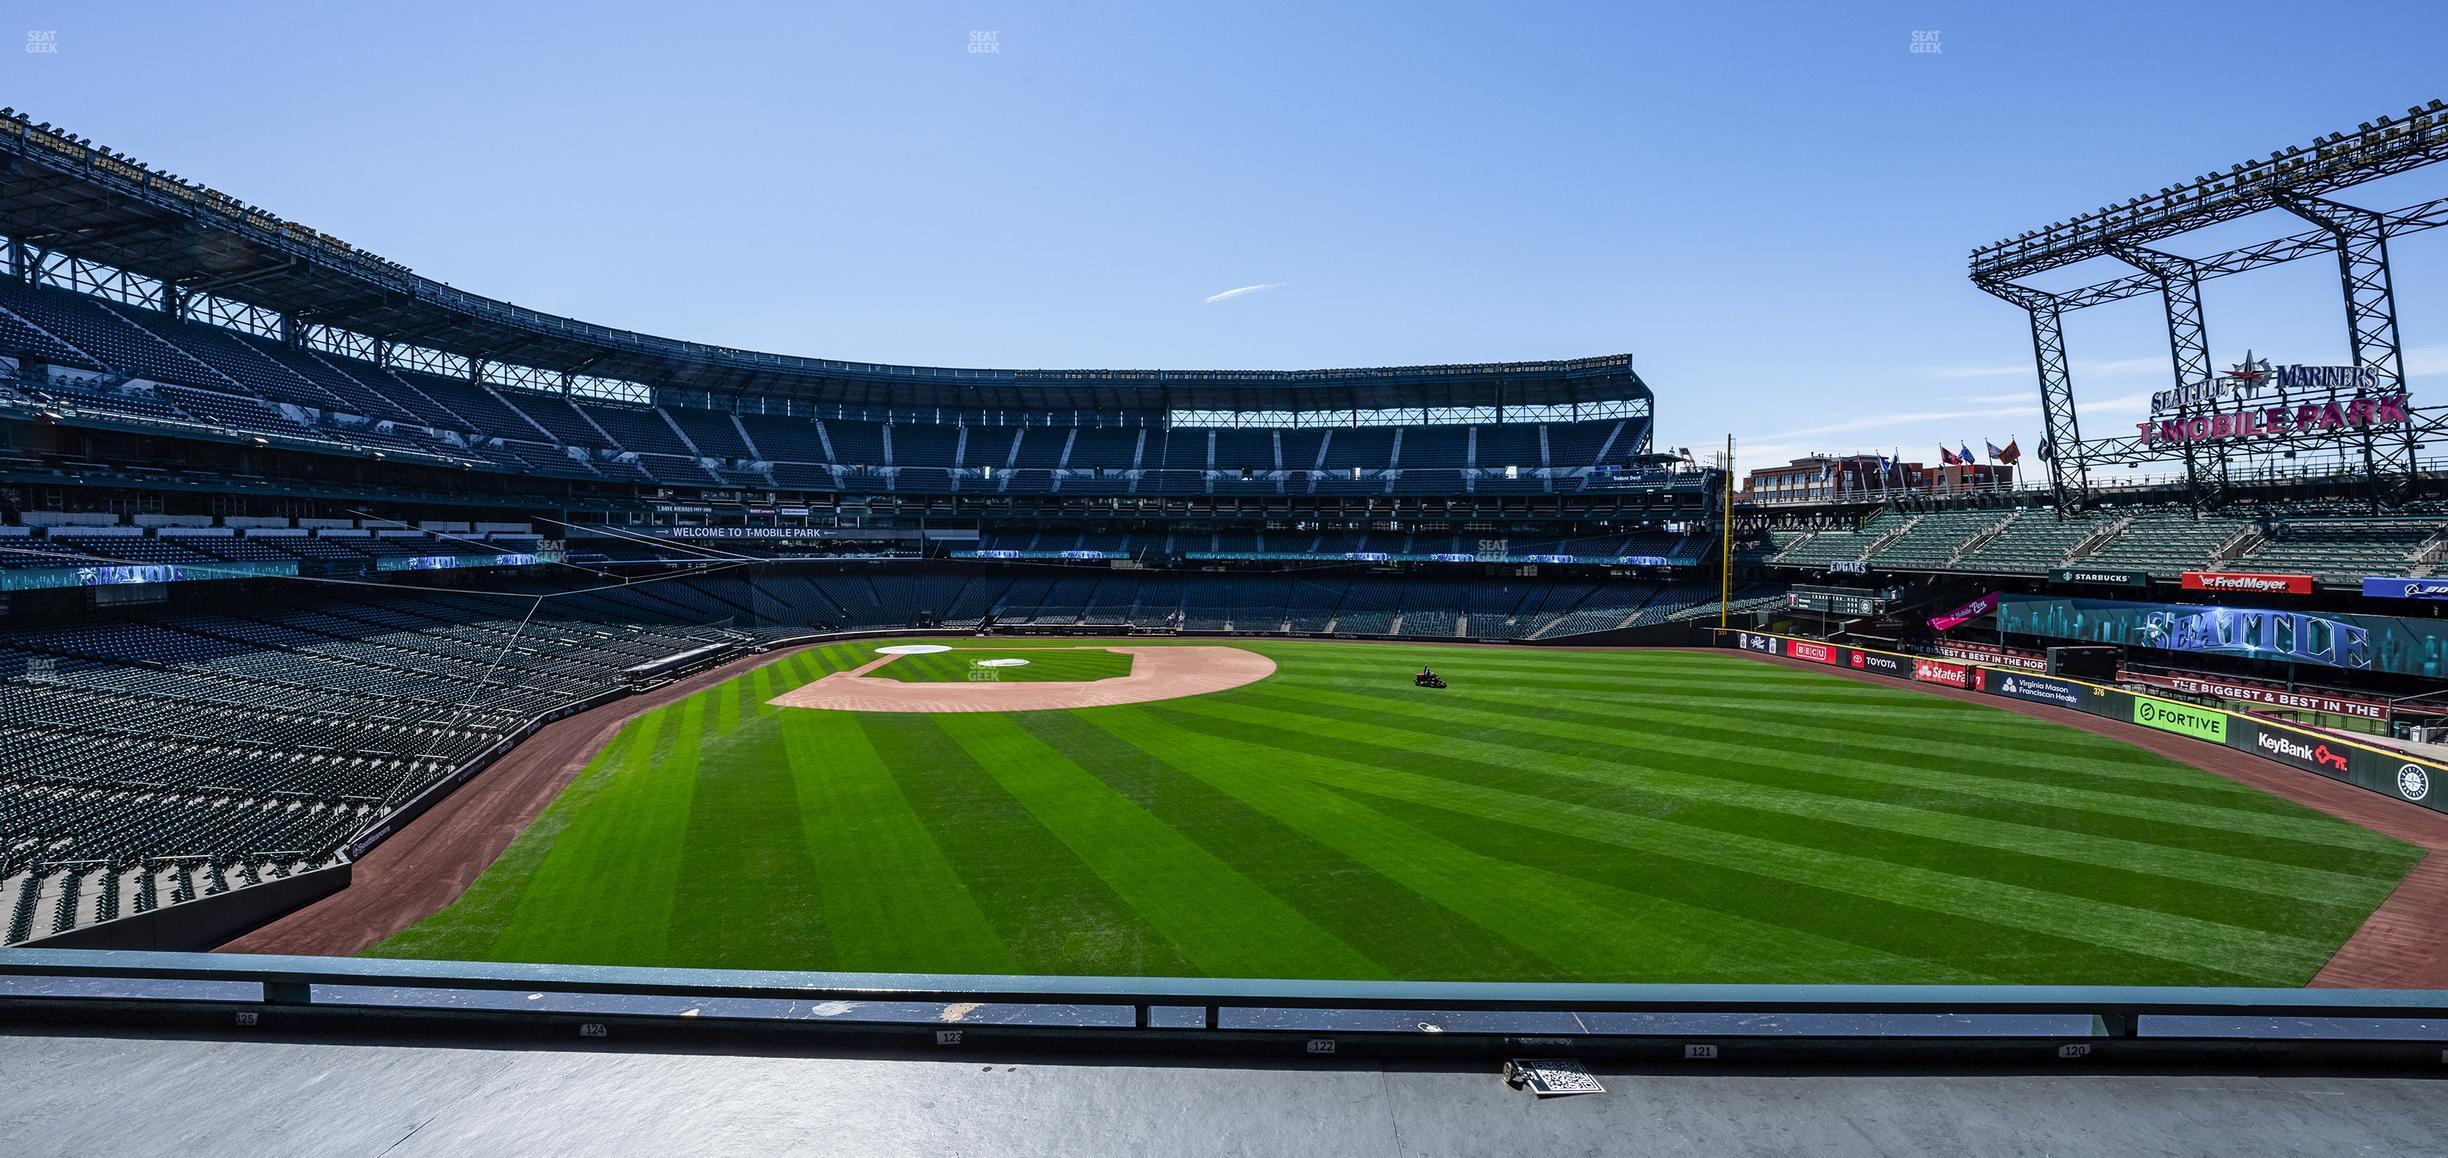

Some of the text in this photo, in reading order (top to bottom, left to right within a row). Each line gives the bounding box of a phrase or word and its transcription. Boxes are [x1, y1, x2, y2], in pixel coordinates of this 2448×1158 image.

[2151, 364, 2380, 414] SEATTLE MARINERS
[2137, 392, 2412, 445] T-MOBILE PARK
[673, 527, 821, 538] WELCOME TO T-MOBILE PARK
[2075, 573, 2128, 582] STARBUCKS
[1798, 646, 1824, 657] BECU
[1866, 656, 1897, 669] TOYOTA
[1960, 650, 1967, 659] &
[1968, 652, 1991, 662] BEST
[1992, 655, 2002, 663] IN
[2003, 657, 2021, 667] THE
[2019, 680, 2068, 693] Virginia Mason
[2019, 687, 2077, 704] Franciscan Health
[2172, 680, 2380, 717] THE BIGGEST & BEST IN THE
[2158, 709, 2220, 733] FORTIVE
[2258, 732, 2313, 761] KeyBank
[1315, 1041, 1333, 1051] 122
[1692, 1046, 1711, 1056] 121
[2065, 1045, 2085, 1056] 120
